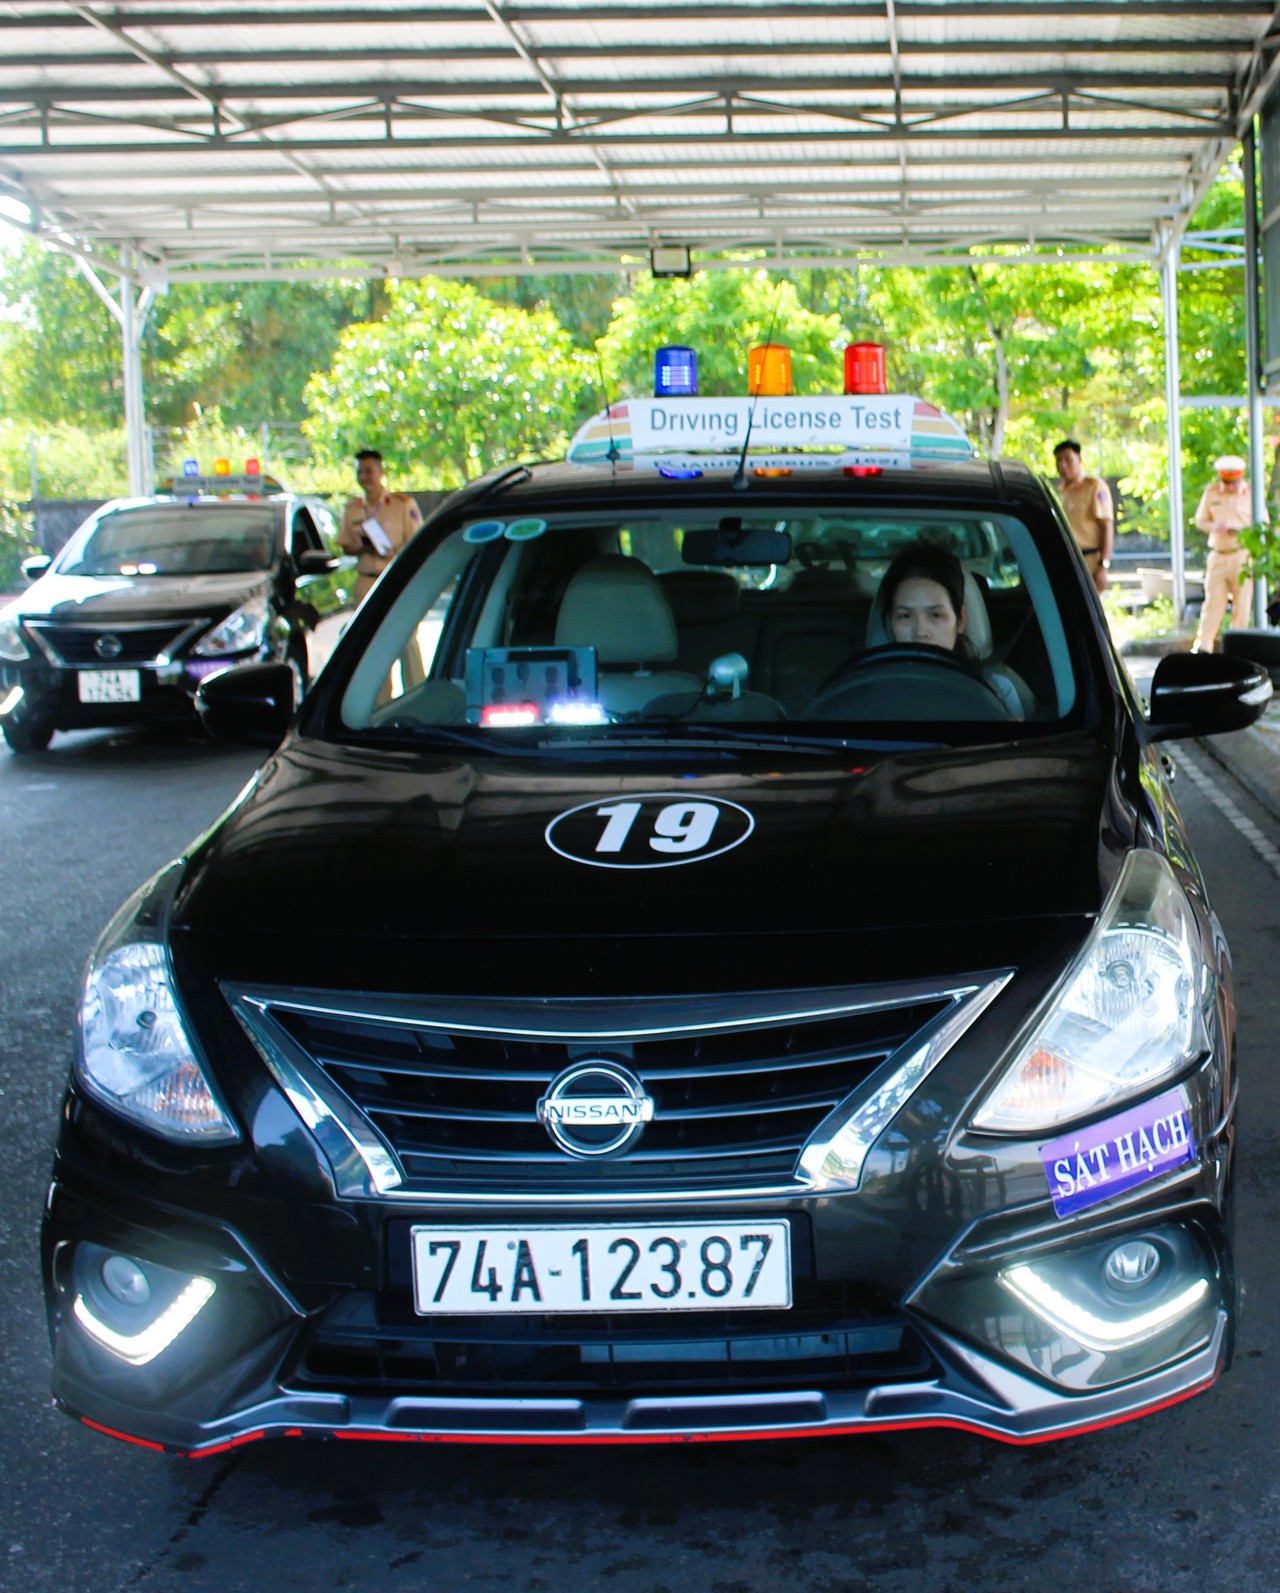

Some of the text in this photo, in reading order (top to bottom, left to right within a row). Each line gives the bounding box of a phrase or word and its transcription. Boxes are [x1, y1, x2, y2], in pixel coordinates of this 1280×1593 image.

[650, 405, 901, 436] Driving License Test
[595, 802, 720, 853] 19
[549, 1104, 638, 1119] NISSAN
[1053, 1110, 1189, 1198] SÁT HẠCH
[429, 1234, 774, 1303] 74A-123.87
